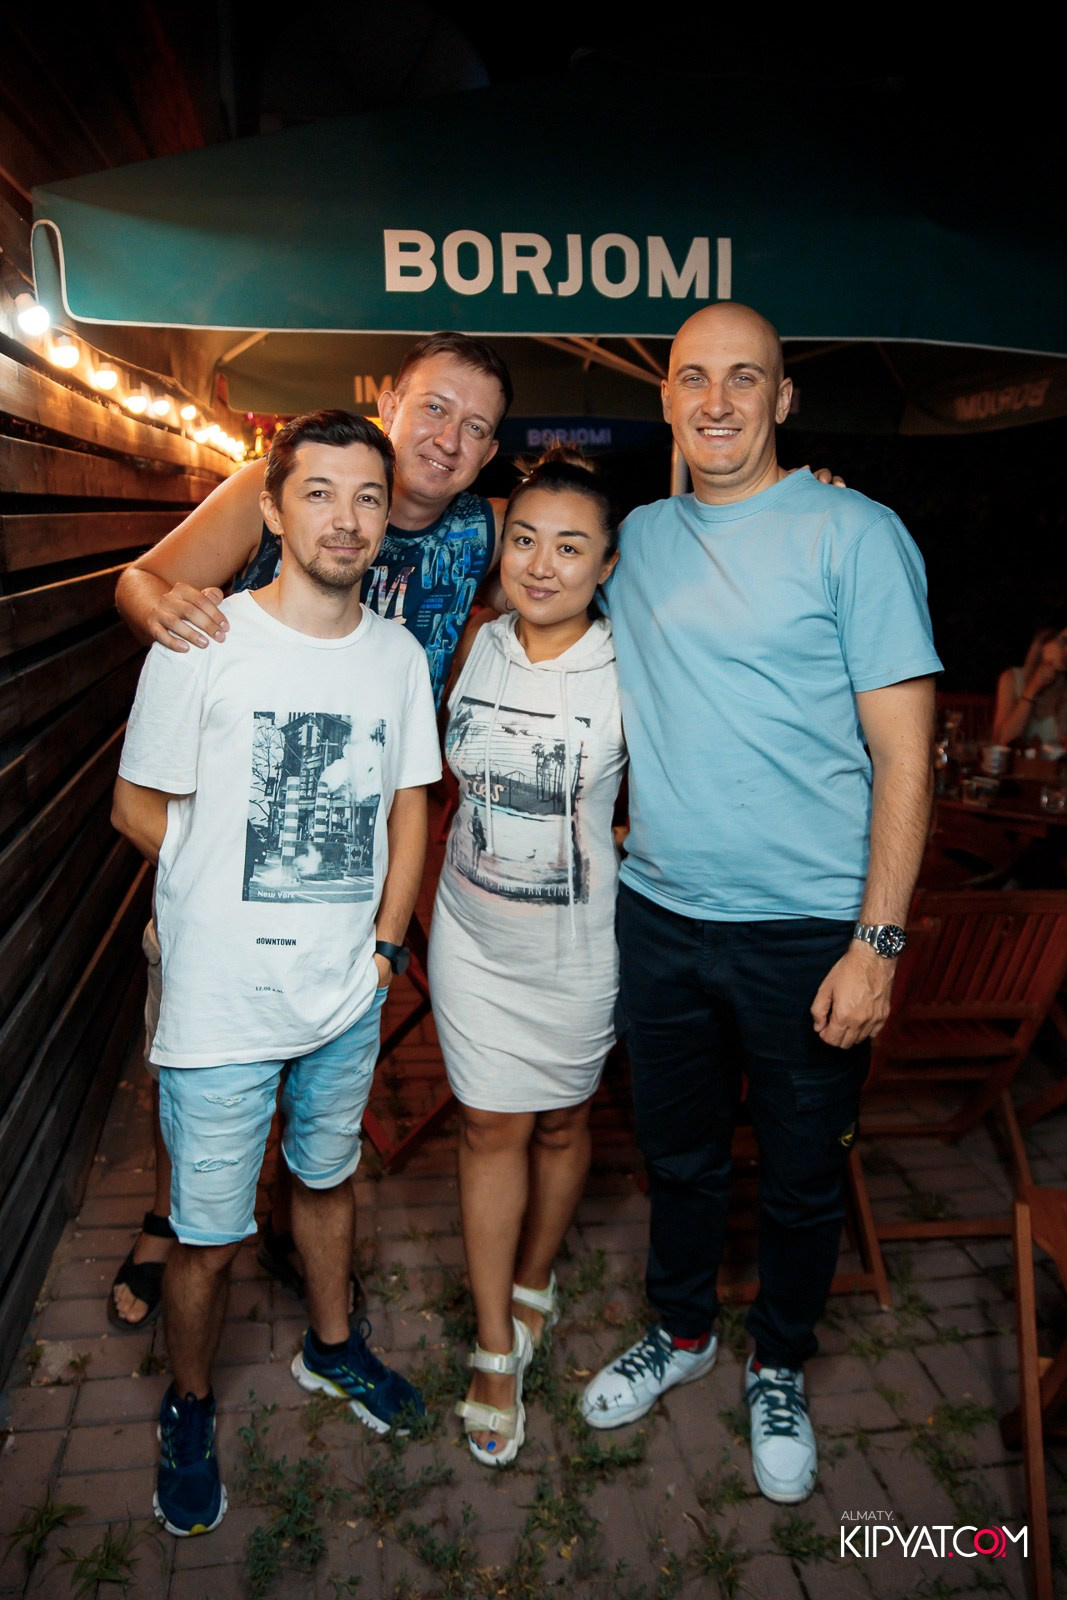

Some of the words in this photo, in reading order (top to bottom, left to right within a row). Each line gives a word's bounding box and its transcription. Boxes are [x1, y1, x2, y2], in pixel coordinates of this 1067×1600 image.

[383, 229, 732, 300] BORJOMI
[527, 428, 612, 446] BORJOMI
[257, 890, 276, 898] New
[277, 891, 295, 899] York
